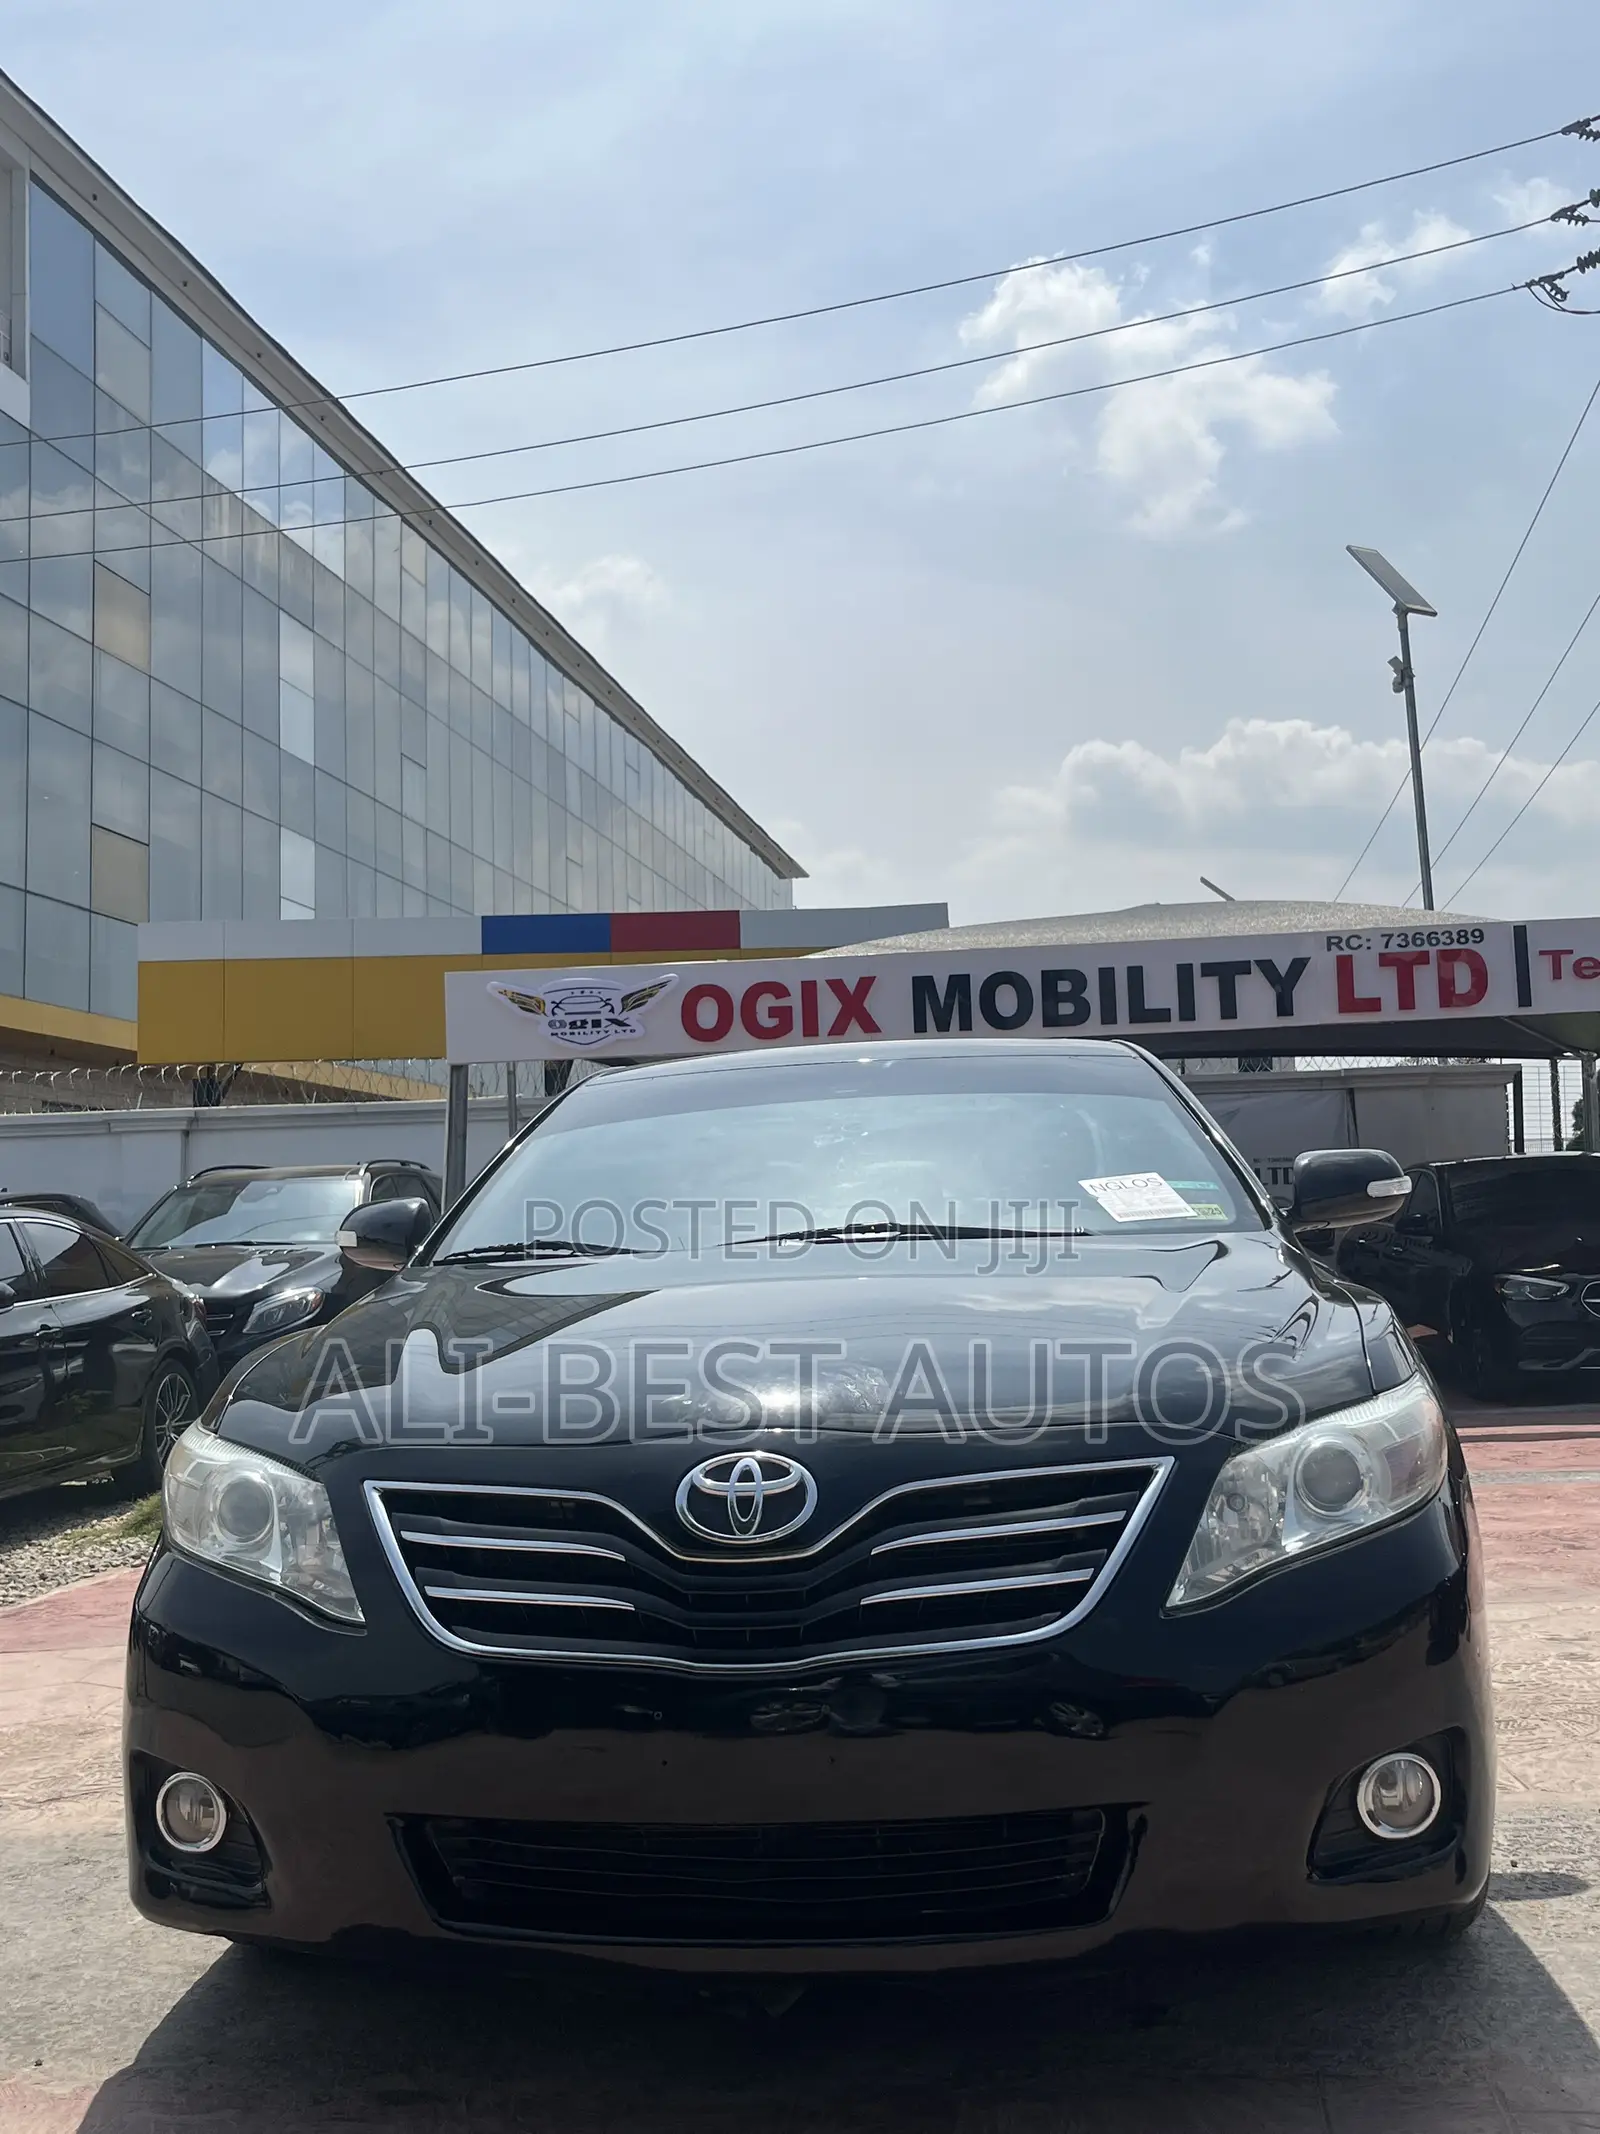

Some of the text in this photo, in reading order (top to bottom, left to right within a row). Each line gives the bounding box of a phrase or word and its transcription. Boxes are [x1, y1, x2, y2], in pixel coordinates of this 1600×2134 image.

[1326, 929, 1485, 952] RC: 7366389
[681, 975, 882, 1042] OGIX
[912, 957, 1311, 1034] MOBILITY
[1336, 948, 1489, 1014] LTD
[551, 1029, 610, 1037] MOBILITY
[1089, 1177, 1163, 1193] NGLOS
